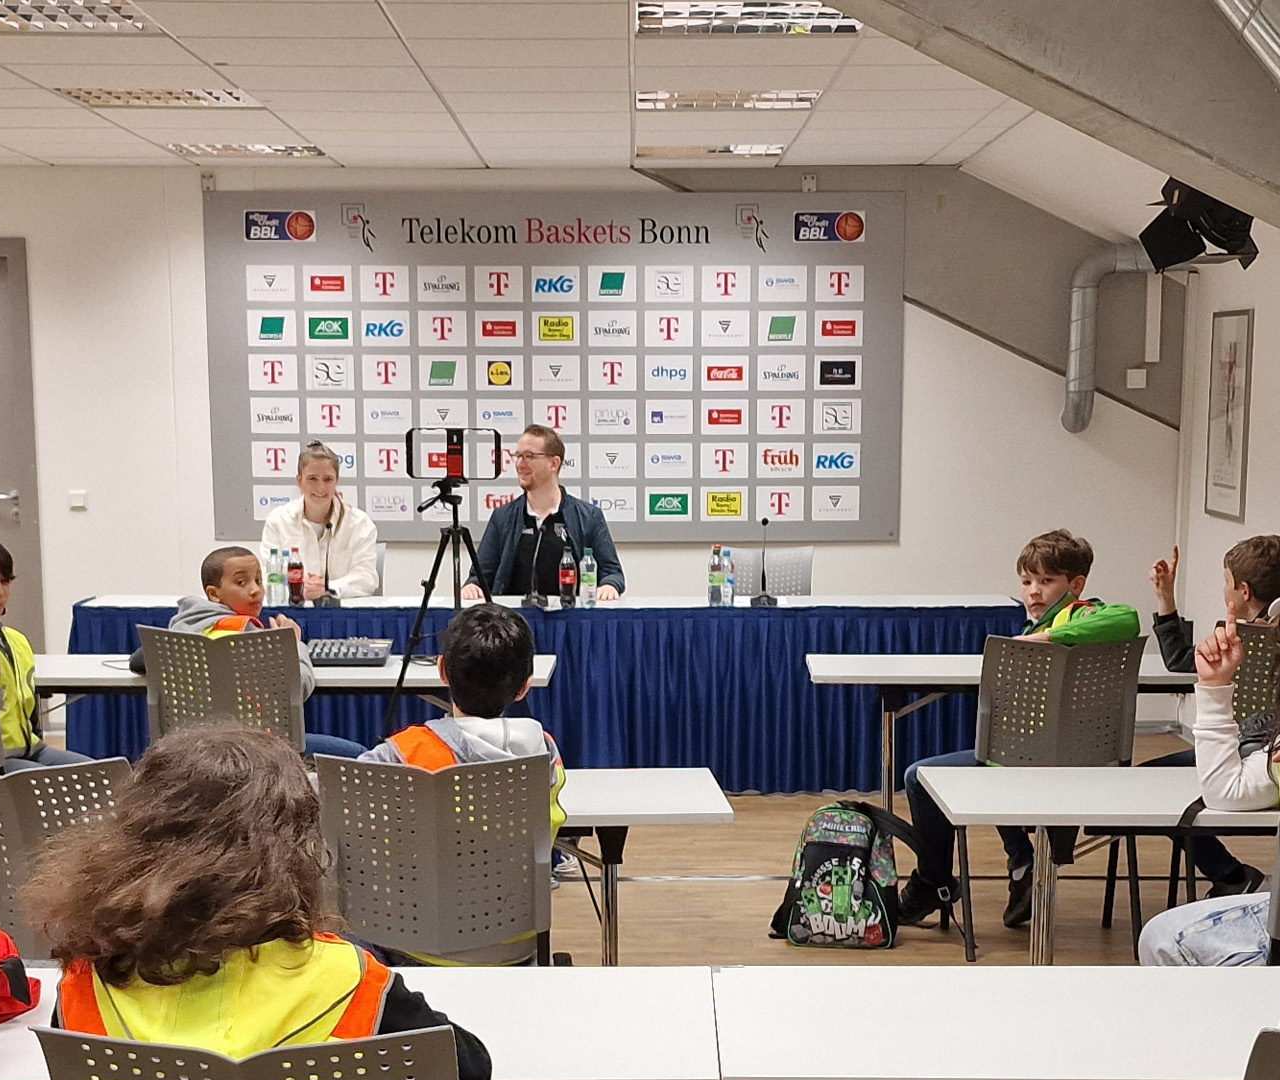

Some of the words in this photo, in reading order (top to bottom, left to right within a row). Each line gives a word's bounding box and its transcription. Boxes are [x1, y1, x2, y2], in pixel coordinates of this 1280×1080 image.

[250, 226, 279, 238] BBL
[402, 217, 518, 244] Telekom
[525, 217, 632, 244] Baskets
[639, 217, 711, 244] Bonn
[799, 227, 828, 239] BBL
[376, 272, 395, 296] T
[423, 282, 460, 292] SPALDING
[490, 272, 509, 297] T
[534, 275, 574, 293] RKG
[717, 272, 736, 296] T
[829, 272, 850, 297] T
[315, 319, 343, 335] AOK
[365, 319, 404, 338] RKG
[433, 318, 453, 341] T
[543, 318, 569, 327] Radio
[593, 326, 631, 336] SPALDING
[660, 318, 678, 341] T
[264, 360, 282, 384] T
[377, 362, 396, 385] T
[603, 362, 622, 385] T
[651, 366, 686, 380] dhpg
[763, 370, 800, 380] SPALDING
[256, 413, 293, 423] SPALDING
[322, 404, 340, 428] T
[548, 406, 566, 429] T
[772, 406, 790, 429] T
[268, 448, 286, 471] T
[379, 449, 398, 472] T
[715, 450, 733, 472] T
[762, 448, 799, 467] früh
[815, 451, 854, 469] RKG
[654, 496, 683, 511] AOK
[711, 494, 737, 503] Radio
[771, 493, 789, 515] T
